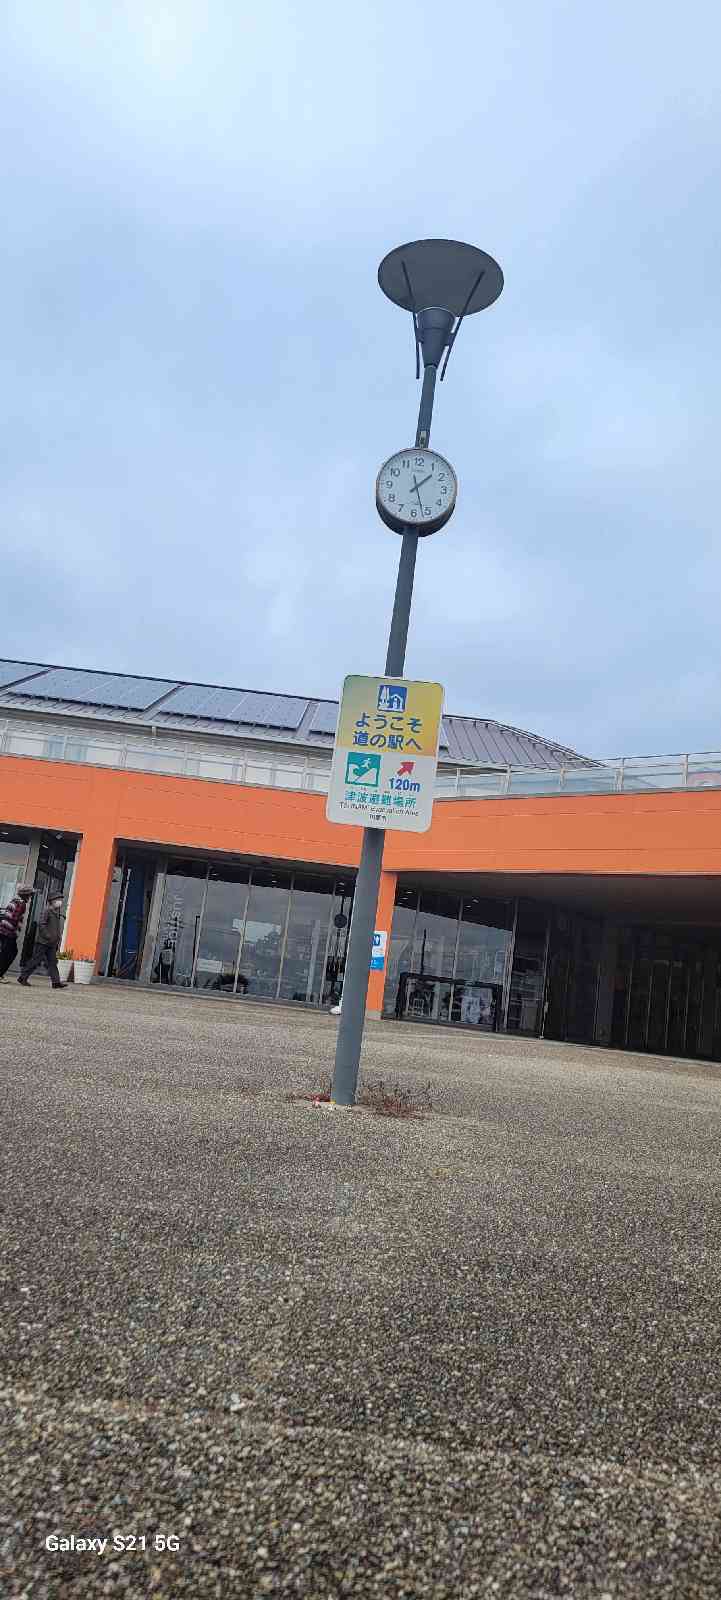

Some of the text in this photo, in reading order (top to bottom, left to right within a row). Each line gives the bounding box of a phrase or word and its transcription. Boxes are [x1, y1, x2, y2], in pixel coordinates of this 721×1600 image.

[402, 459, 410, 468] 11
[414, 457, 425, 467] 12
[390, 468, 401, 477] 10
[438, 473, 446, 482] 2
[386, 480, 393, 488] 9
[441, 486, 447, 495] 3
[388, 493, 395, 503] 8
[436, 498, 442, 506] 4
[397, 504, 404, 512] 7
[424, 506, 432, 516] 5
[410, 509, 417, 517] 6
[355, 712, 423, 734] ようこそ
[352, 731, 423, 751] 道の駅へ
[388, 777, 421, 793] 120m
[344, 790, 417, 809] 津波避難場所
